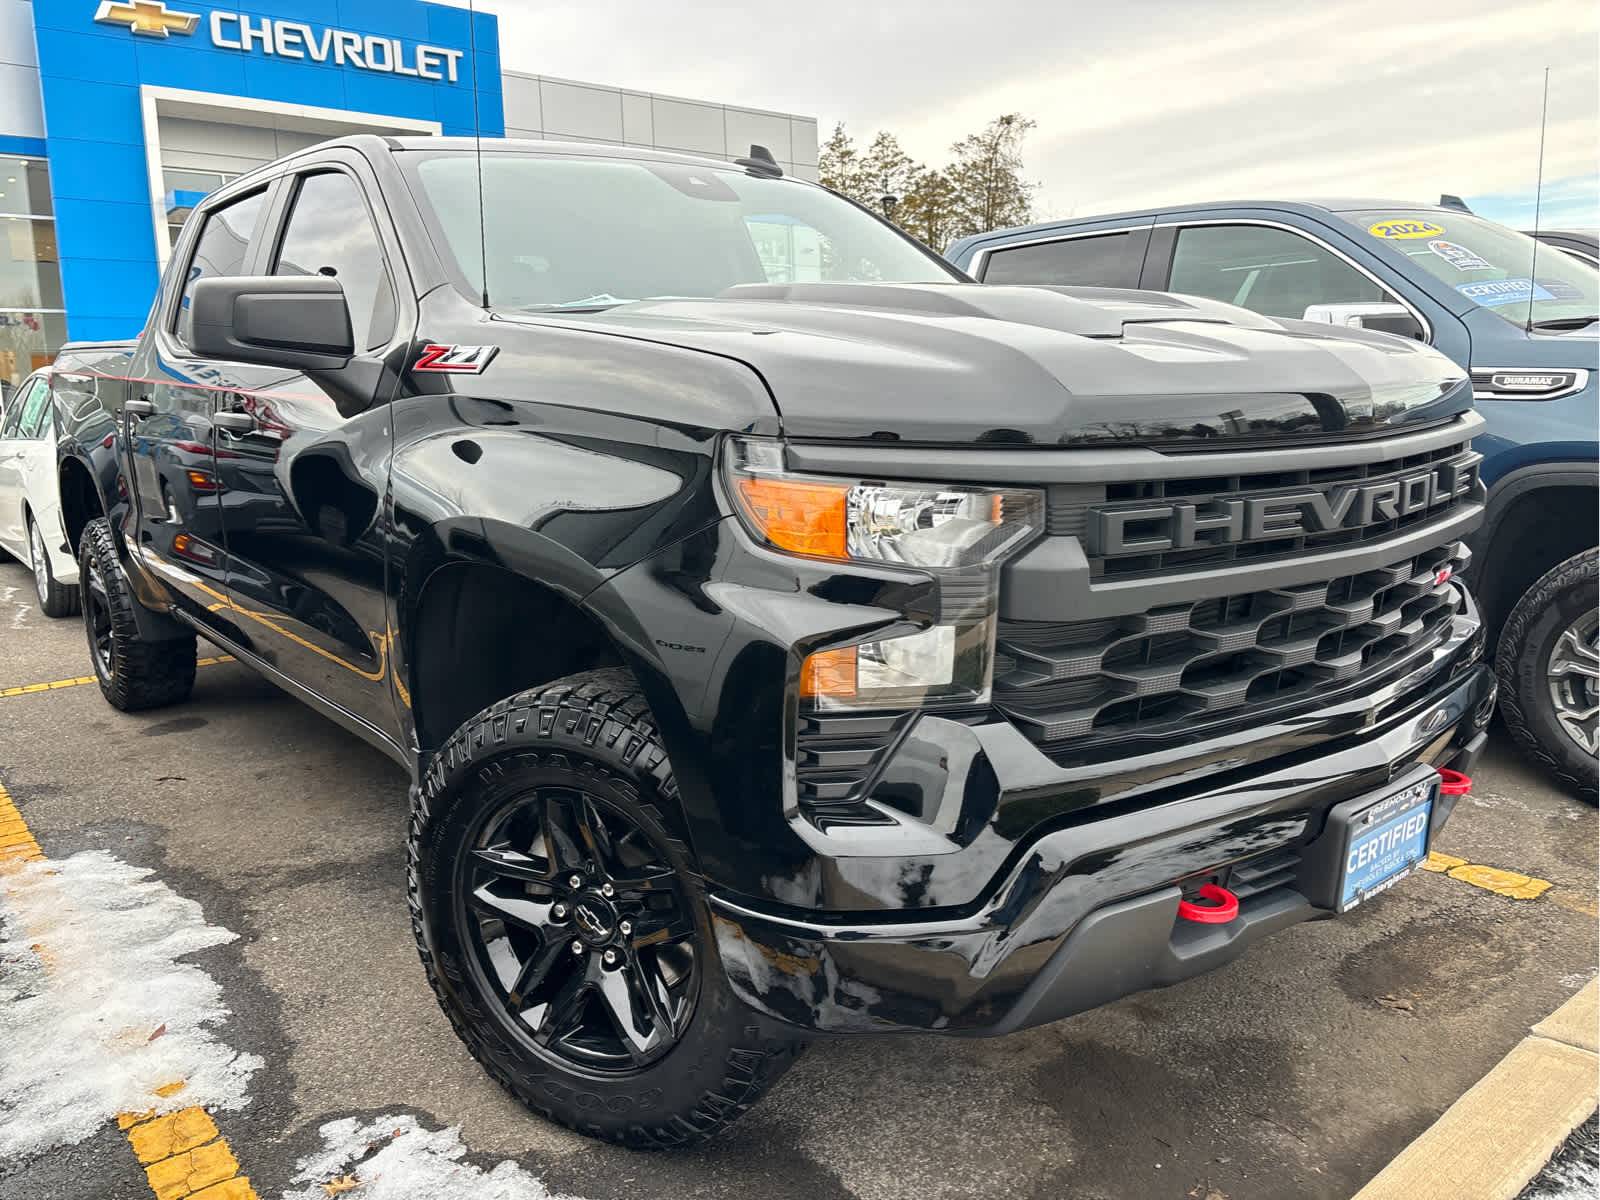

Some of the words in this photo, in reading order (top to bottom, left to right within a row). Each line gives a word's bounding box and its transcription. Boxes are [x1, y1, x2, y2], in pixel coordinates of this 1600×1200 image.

[210, 10, 464, 82] CHEVROLET
[1377, 223, 1440, 236] 2024
[413, 344, 500, 374] Z71
[1503, 377, 1553, 385] DURAMAX
[1346, 812, 1427, 873] CERTIFIED
